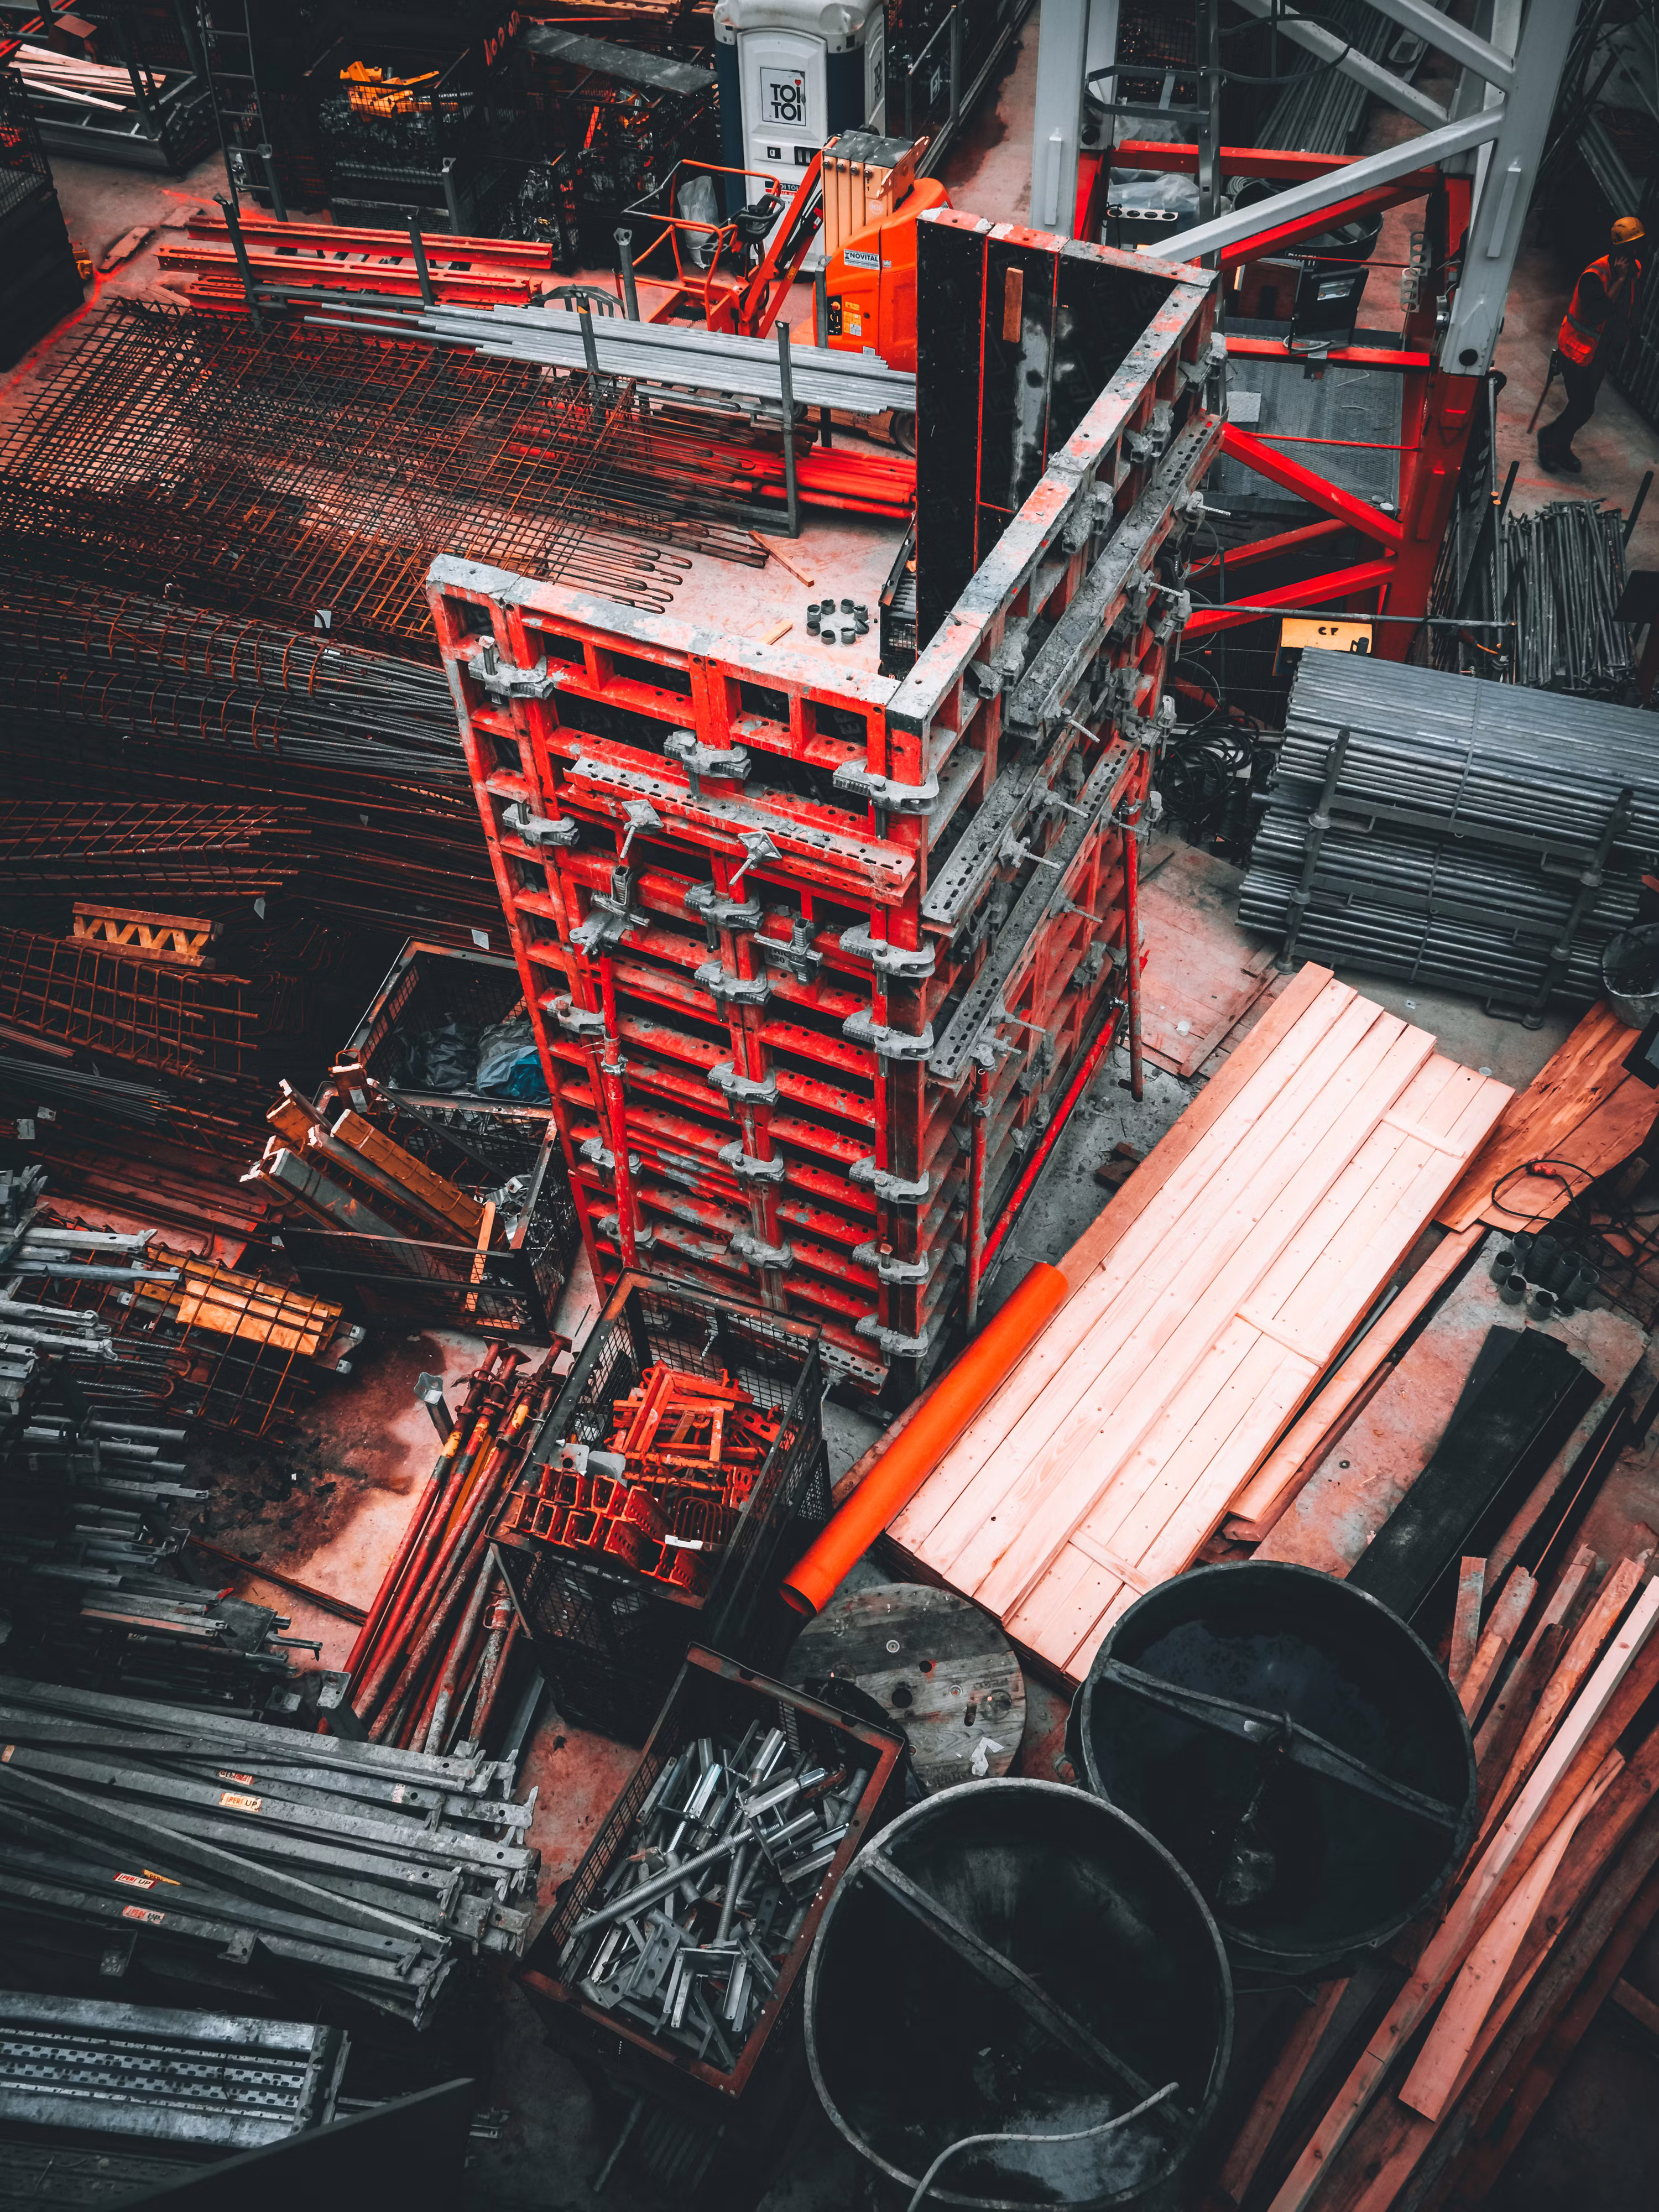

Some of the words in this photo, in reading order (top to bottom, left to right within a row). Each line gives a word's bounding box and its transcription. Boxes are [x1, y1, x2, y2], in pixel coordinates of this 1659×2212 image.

[770, 81, 801, 103] TOI
[771, 101, 801, 121] TOI
[850, 252, 879, 262] NOVITAL
[228, 1796, 244, 1805] PERI
[245, 1799, 258, 1808] UP
[132, 1909, 146, 1917] PERI
